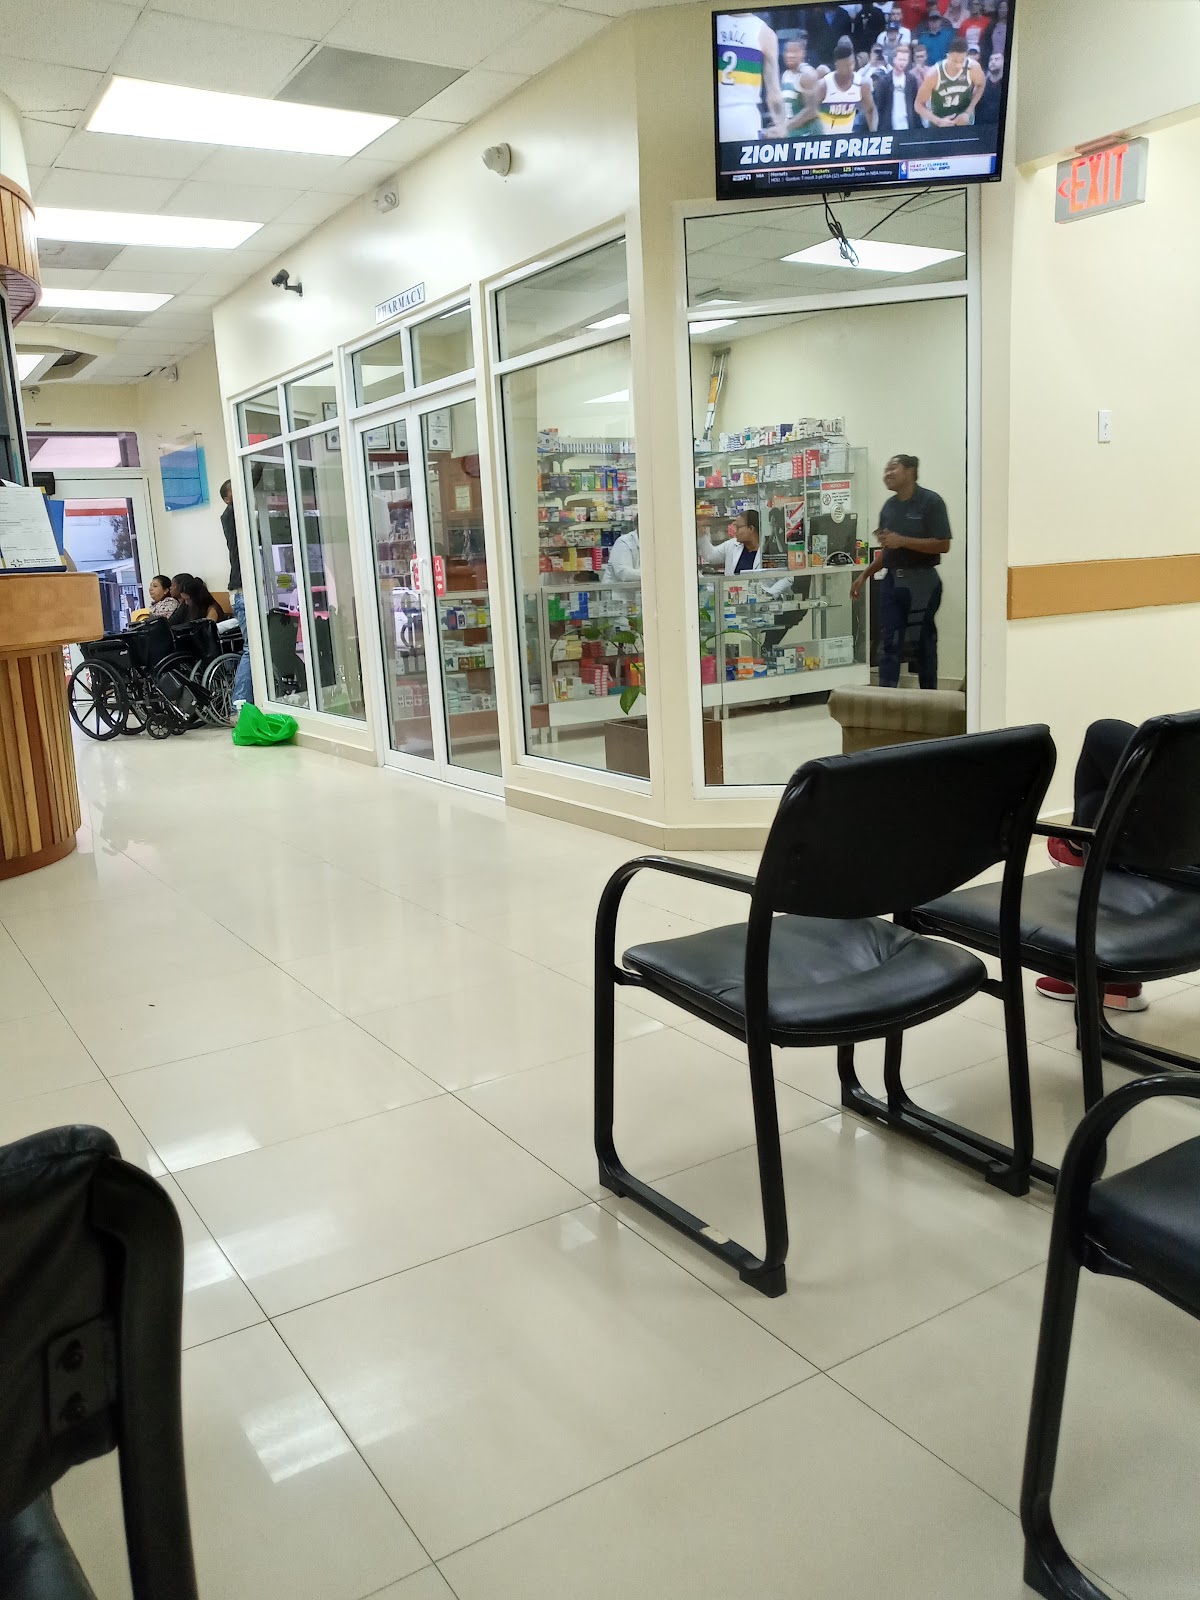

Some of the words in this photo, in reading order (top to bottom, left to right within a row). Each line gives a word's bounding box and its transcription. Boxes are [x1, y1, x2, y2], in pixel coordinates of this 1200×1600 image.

[720, 50, 738, 86] 2
[740, 143, 789, 165] ZION
[793, 140, 832, 161] THE
[835, 136, 894, 158] PRIZE
[1069, 143, 1130, 214] EXIT
[377, 286, 423, 318] PHARMACY
